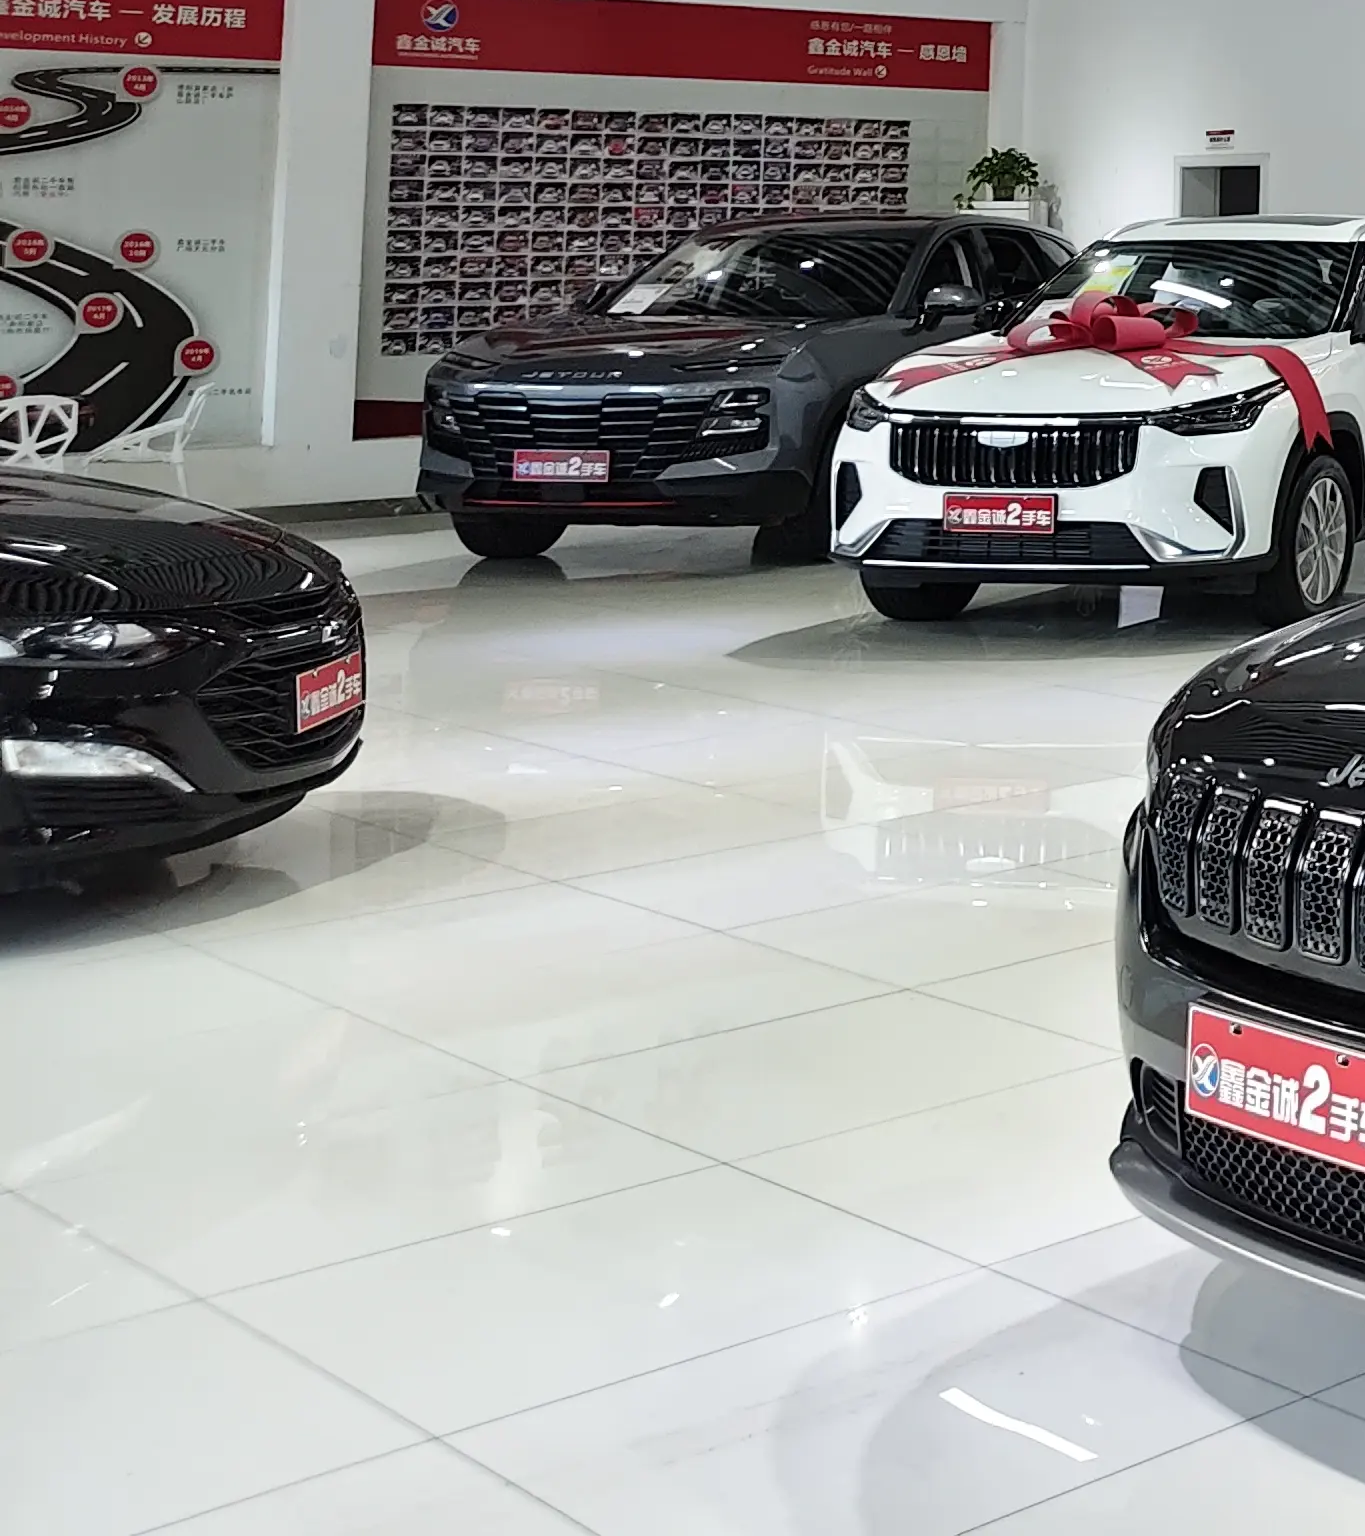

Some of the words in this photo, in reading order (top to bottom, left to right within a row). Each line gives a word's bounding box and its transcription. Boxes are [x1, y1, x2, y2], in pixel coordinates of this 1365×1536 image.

[152, 3, 248, 30] 发展历程
[79, 33, 128, 49] History
[395, 33, 482, 54] 鑫金诚汽车
[807, 37, 893, 60] 鑫金诚汽车
[919, 43, 968, 63] 感恩墙
[521, 370, 623, 379] JETOUR
[962, 502, 1052, 527] 鑫金诚2手车
